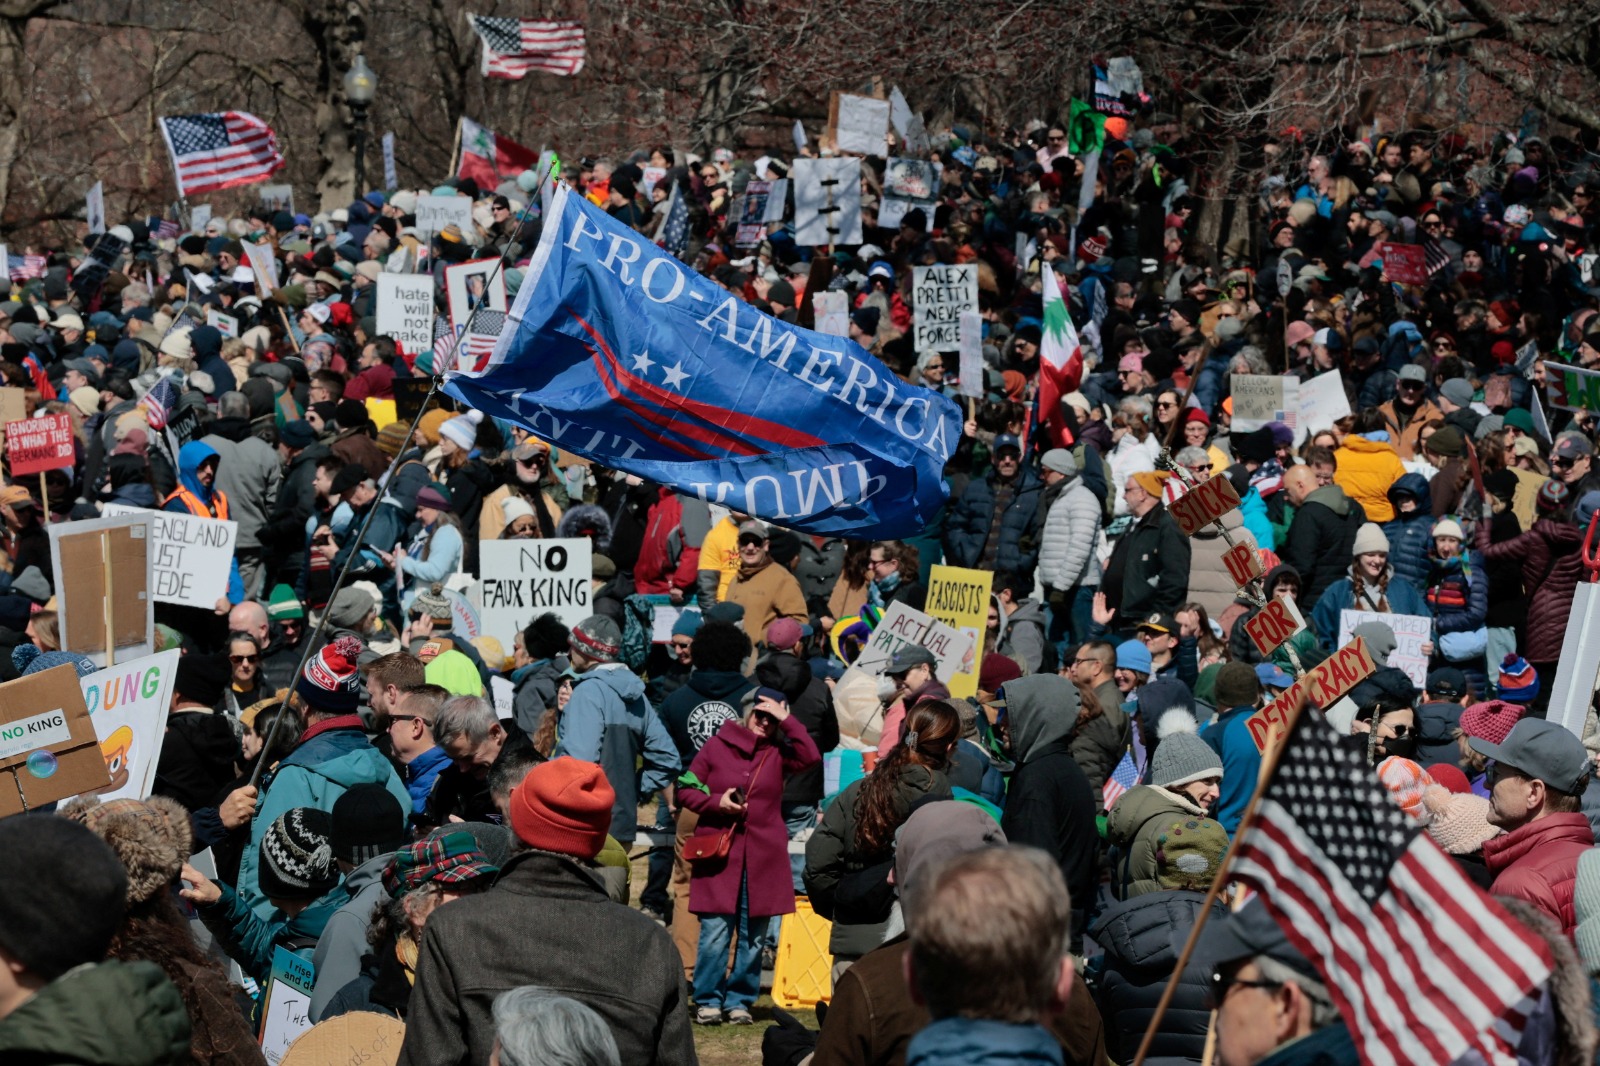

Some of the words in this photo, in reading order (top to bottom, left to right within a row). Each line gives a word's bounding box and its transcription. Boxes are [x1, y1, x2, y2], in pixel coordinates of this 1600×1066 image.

[923, 268, 969, 285] ALEX
[395, 286, 430, 300] hate
[917, 286, 969, 304] PRETTI
[403, 303, 429, 316] will
[404, 318, 429, 330] not
[386, 330, 429, 343] make
[563, 211, 950, 461] PRO-AMERICA
[918, 325, 962, 346] FORGE
[1234, 386, 1275, 396] AMERICANS
[1236, 377, 1269, 386] FELLOW
[7, 417, 57, 436] IGNORING
[60, 415, 69, 428] IT
[8, 437, 20, 451] IS
[21, 432, 48, 449] WHAT
[50, 428, 70, 444] THE
[11, 446, 56, 463] GERMANS
[57, 443, 73, 457] DID
[1170, 474, 1238, 532] STICK
[521, 544, 569, 573] NO
[1222, 545, 1254, 586] UP
[483, 579, 525, 608] FAUX
[530, 577, 588, 608] KING
[928, 580, 984, 615] FASCISTS
[890, 613, 951, 657] ACTUAL
[1246, 600, 1299, 655] FOR
[86, 666, 161, 716] DUNG
[690, 707, 704, 724] FAN
[2, 726, 24, 741] NO
[27, 715, 63, 733] KING
[284, 970, 301, 986] and
[289, 959, 293, 967] I
[294, 963, 312, 979] rise
[283, 1000, 308, 1027] THE
[373, 1025, 390, 1053] of
